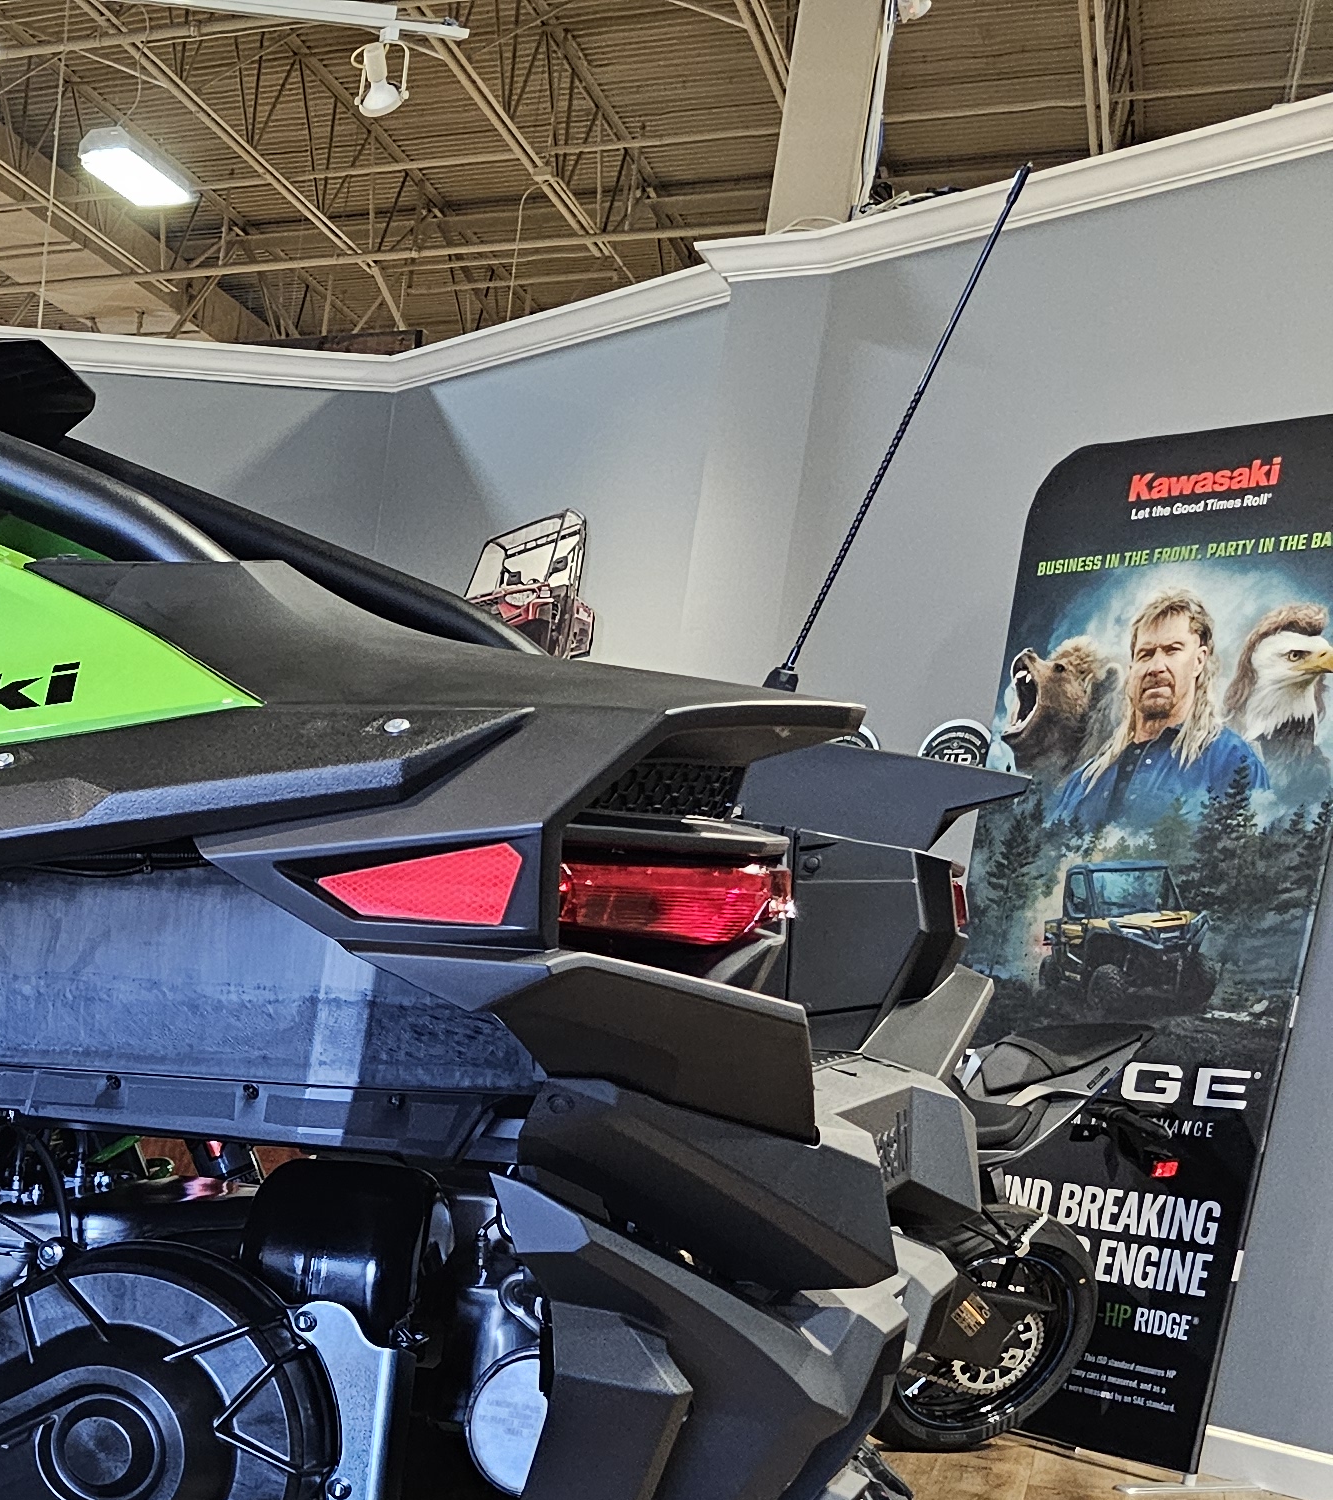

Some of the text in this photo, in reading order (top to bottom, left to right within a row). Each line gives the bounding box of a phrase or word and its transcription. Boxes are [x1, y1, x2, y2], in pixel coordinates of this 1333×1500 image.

[1128, 456, 1282, 502] Kawasaki
[1130, 507, 1149, 520] Let
[1151, 505, 1171, 517] the
[1172, 499, 1204, 515] Good
[1205, 497, 1241, 511] Times
[1037, 555, 1102, 576] BUSINESS
[1105, 553, 1120, 569] IN
[1123, 550, 1150, 567] THE
[1153, 544, 1202, 564] FRONT.
[1206, 539, 1255, 558] PARTY
[1258, 536, 1274, 553] IN
[1278, 533, 1308, 551] THE
[1057, 1182, 1222, 1246] BREAKING
[1094, 1238, 1214, 1297] ENGINE
